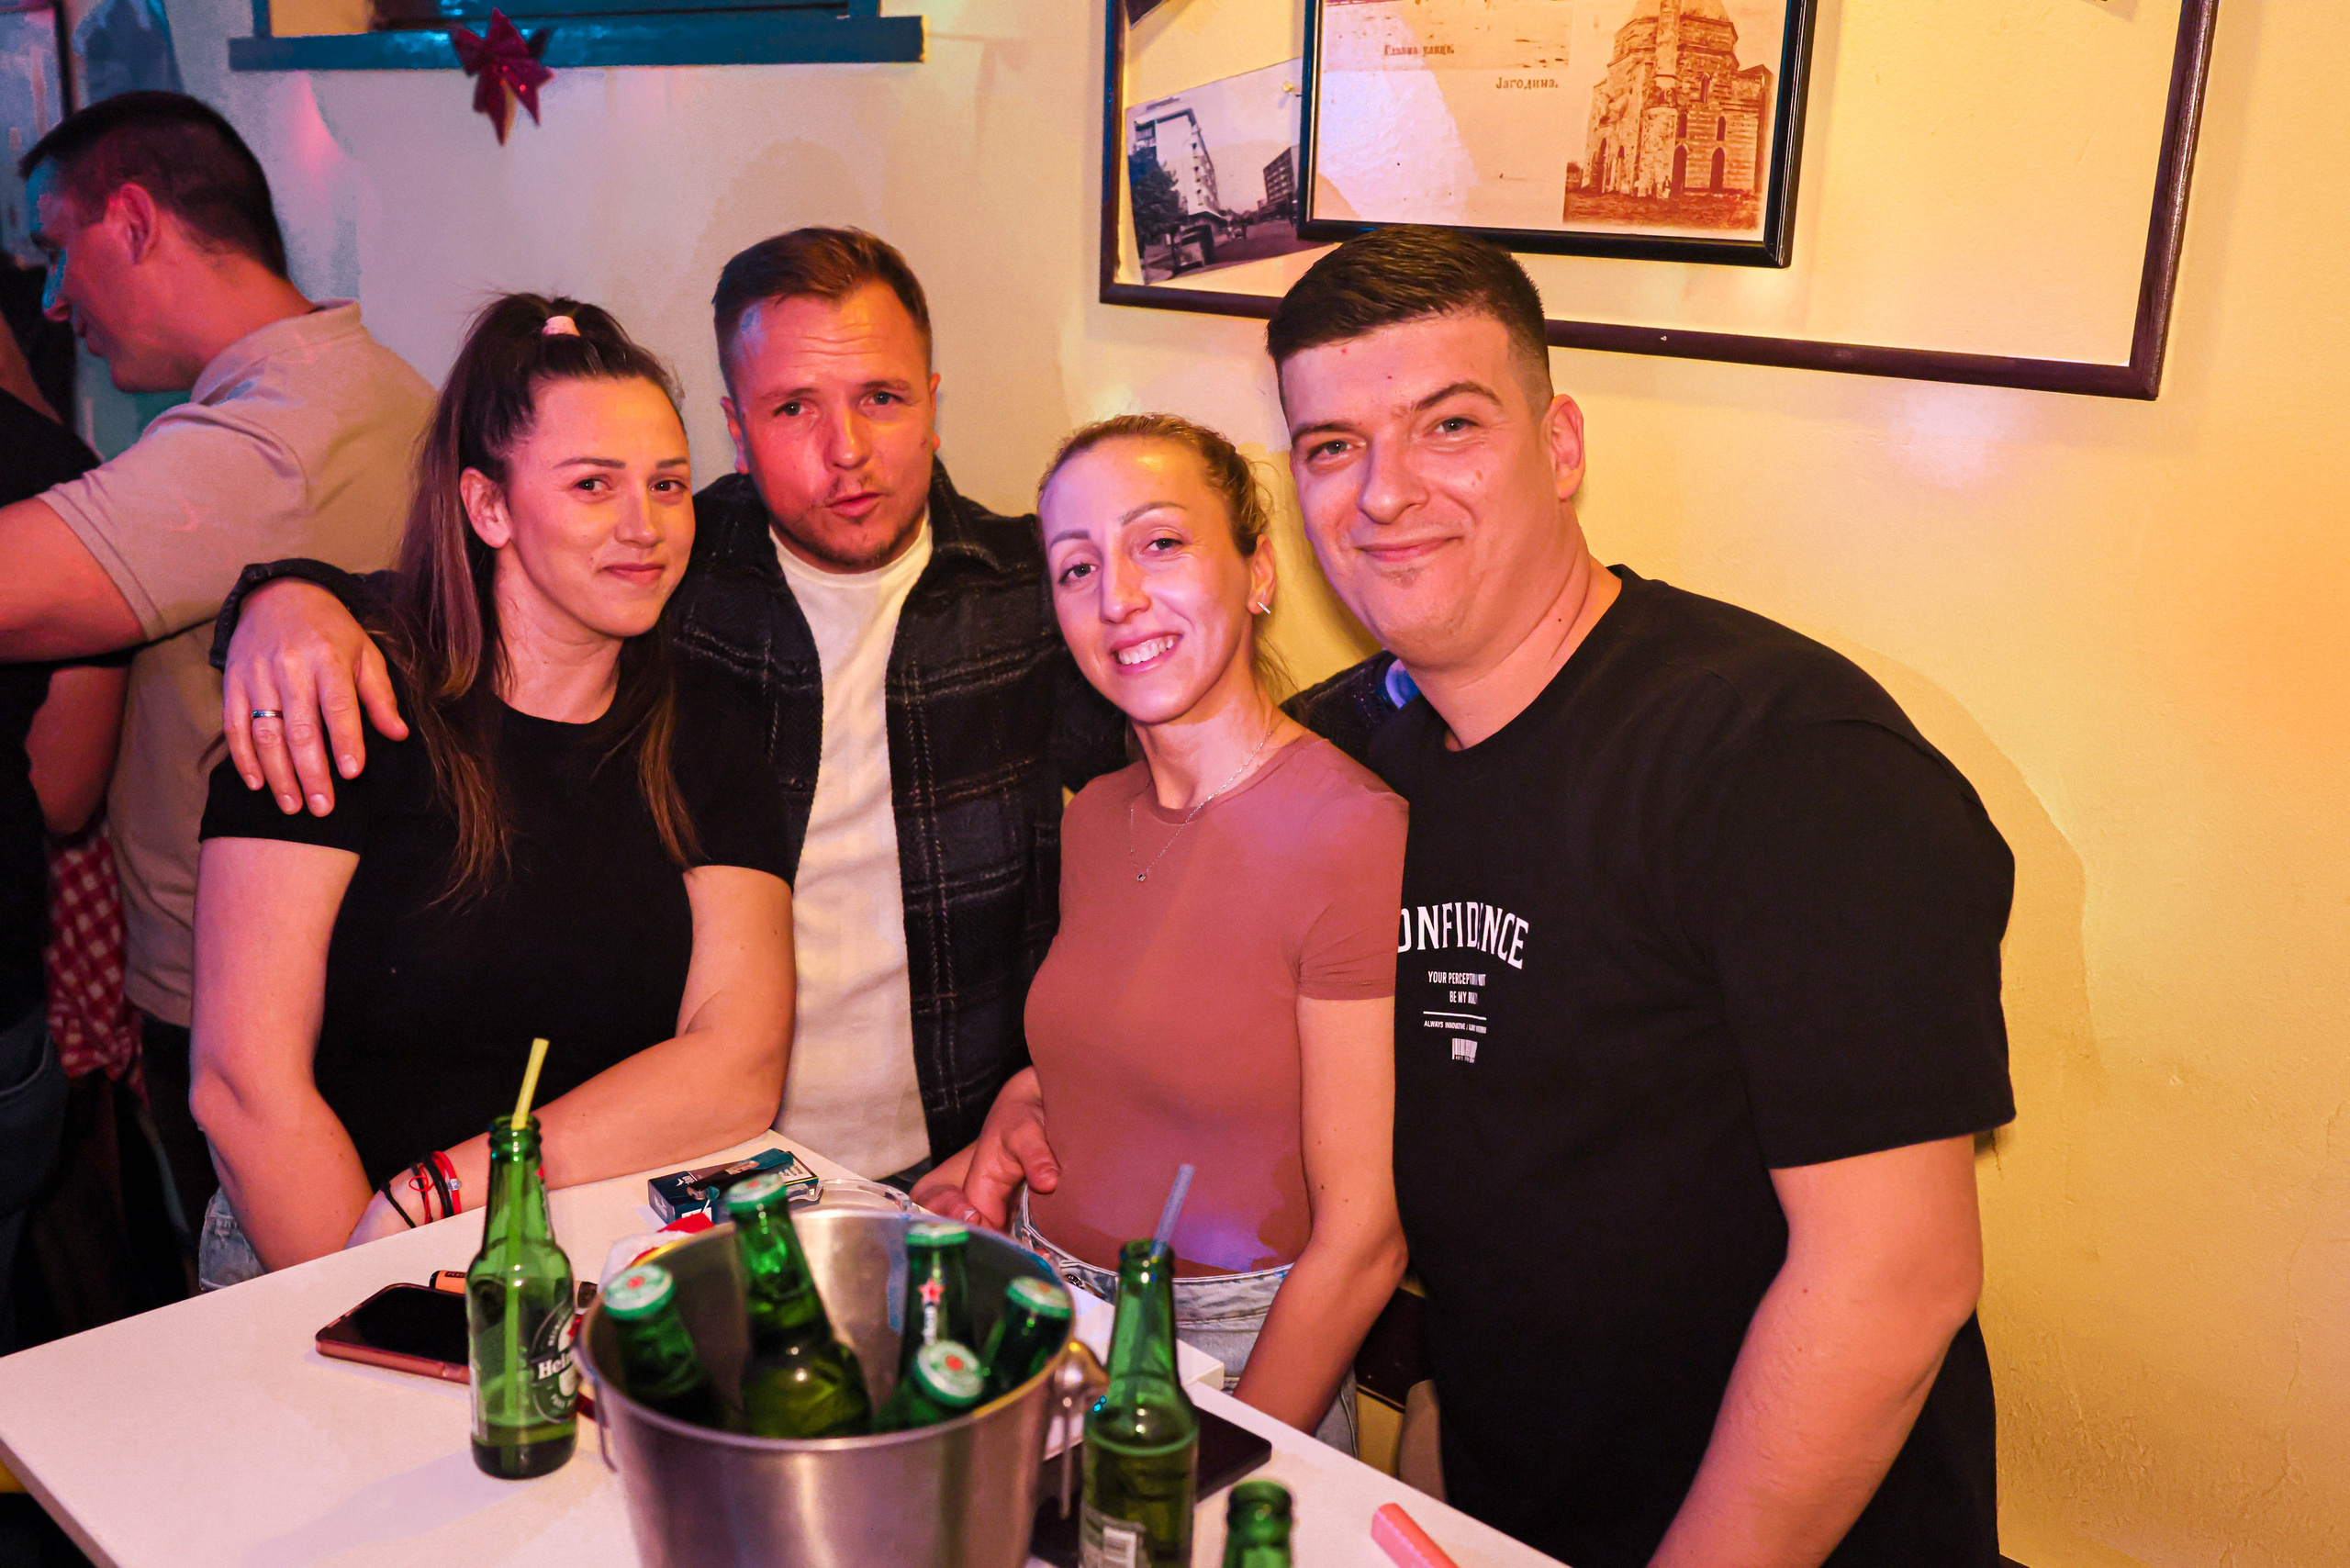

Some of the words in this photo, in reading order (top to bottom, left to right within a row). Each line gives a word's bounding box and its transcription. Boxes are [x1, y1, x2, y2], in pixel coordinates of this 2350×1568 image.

[1495, 77, 1559, 90] Јагодина.
[1397, 902, 1529, 969] ONFIDNCE
[1427, 971, 1447, 983] YOUR
[1449, 991, 1457, 1002] BE
[1458, 991, 1467, 1003] MY
[1424, 1020, 1444, 1028] ALWAYS
